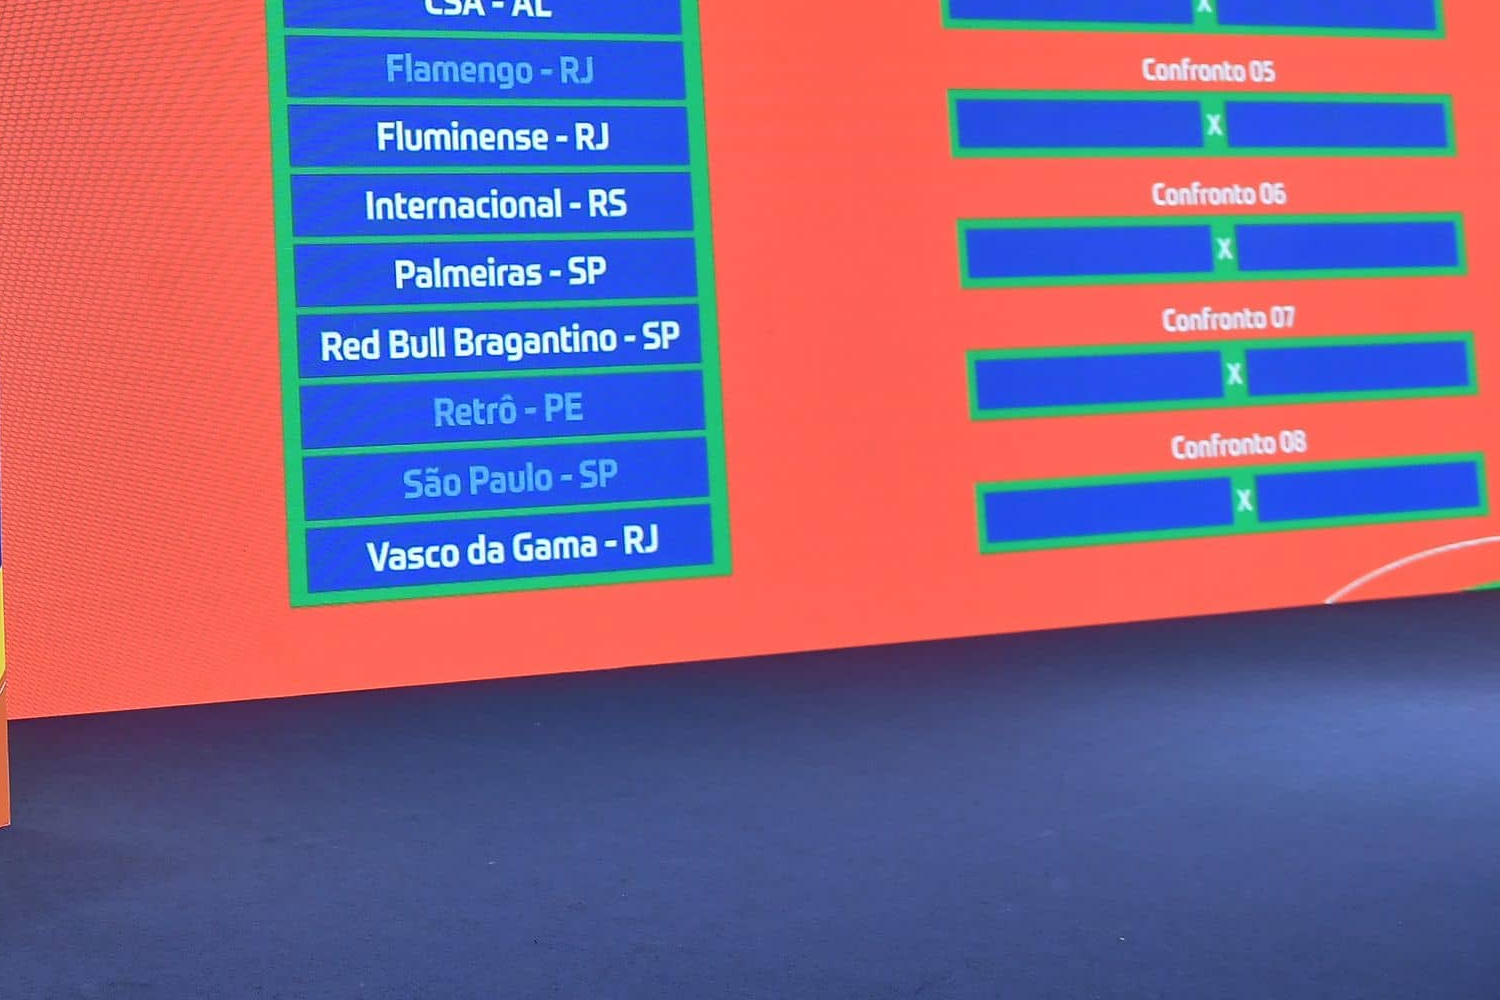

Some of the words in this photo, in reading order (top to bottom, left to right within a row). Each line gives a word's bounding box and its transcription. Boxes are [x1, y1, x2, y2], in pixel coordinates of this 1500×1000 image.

[386, 53, 533, 90] Flamengo
[560, 56, 594, 85] RJ
[1142, 57, 1246, 83] Confronto
[1249, 60, 1276, 83] 05
[377, 120, 548, 152] Fluminense
[575, 122, 610, 152] RJ
[366, 188, 562, 221] Internacional
[588, 188, 627, 218] RS
[1152, 182, 1256, 207] Confronto
[1259, 181, 1287, 206] 06
[395, 257, 542, 289] Palmeiras
[568, 256, 607, 285] SP
[1161, 307, 1267, 333] Confronto
[1270, 305, 1296, 330] 07
[321, 328, 380, 362] Red
[388, 326, 446, 360] Bull
[454, 323, 617, 362] Bragantino
[642, 320, 680, 351] SP
[434, 394, 517, 428] Retrô
[545, 392, 583, 422] PE
[1171, 433, 1276, 461] Confronto
[1279, 429, 1308, 455] 08
[403, 466, 461, 499] São
[469, 462, 553, 496] Paulo
[579, 459, 618, 489] SP
[366, 540, 460, 572] Vasco
[467, 534, 505, 565] da
[512, 532, 598, 562] Gama
[623, 524, 659, 555] RJ
